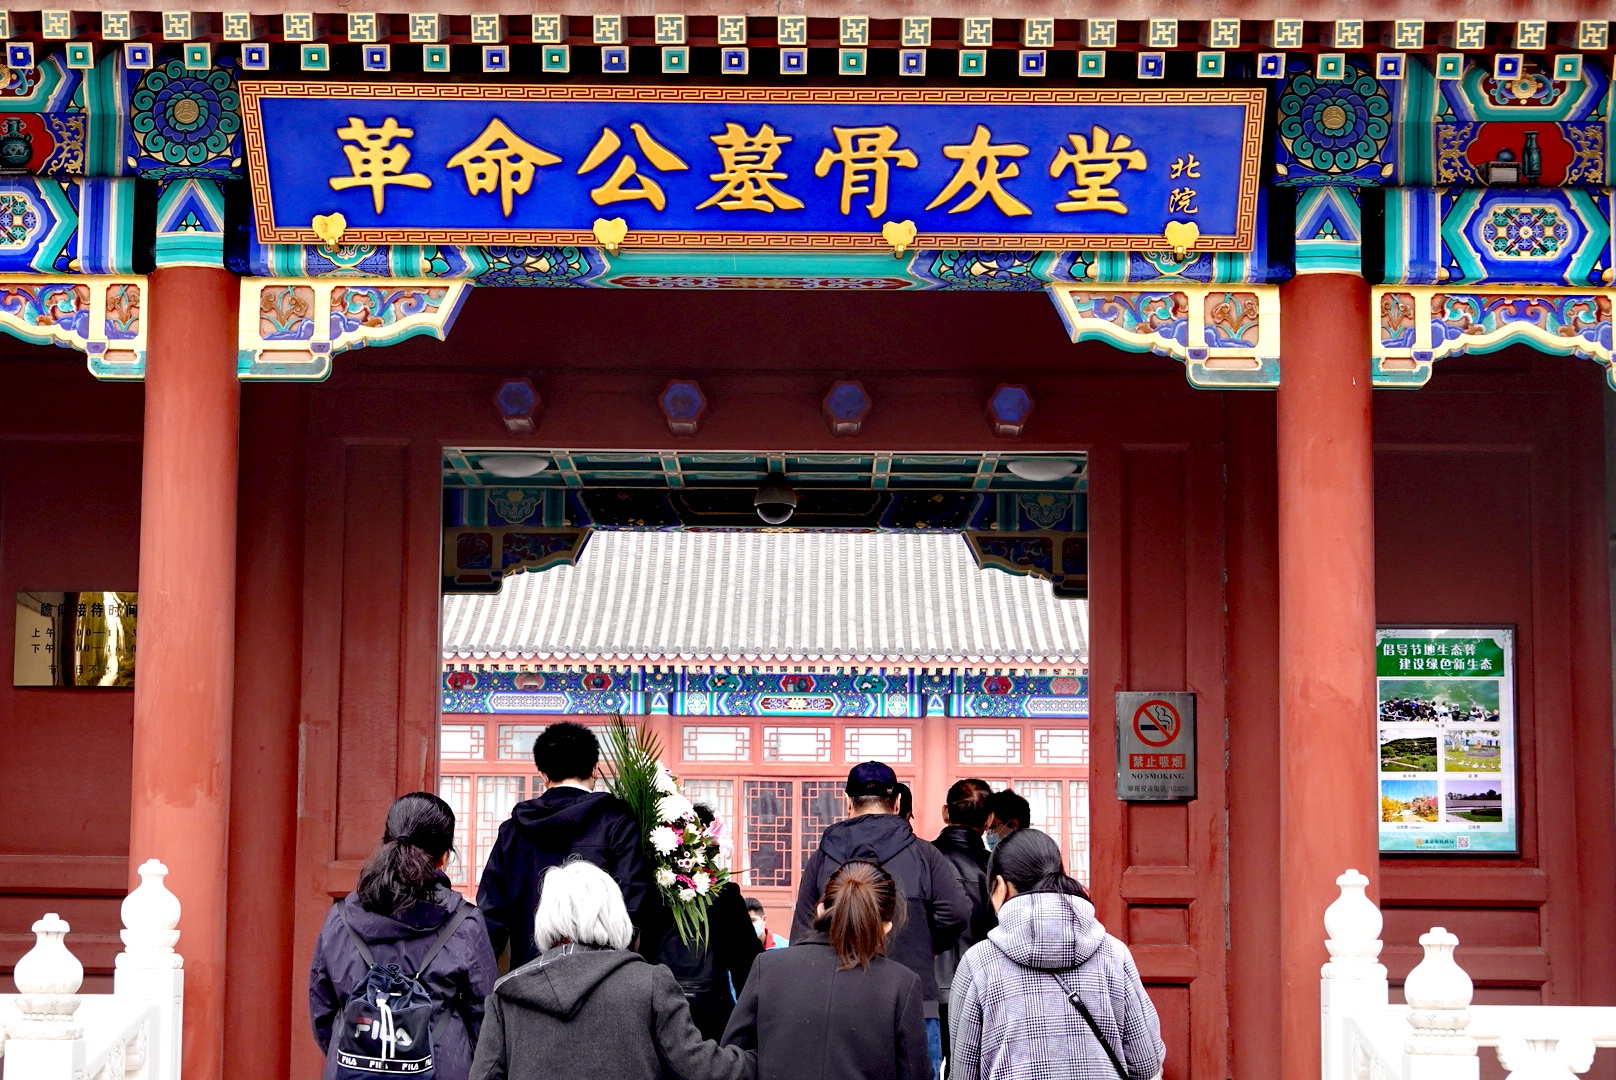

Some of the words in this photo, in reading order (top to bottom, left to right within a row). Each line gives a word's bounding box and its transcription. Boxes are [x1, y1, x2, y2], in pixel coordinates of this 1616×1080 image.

[328, 116, 1148, 219] 革命公墓骨灰堂
[1169, 153, 1201, 213] 北院
[1383, 643, 1477, 656] 倡导节地生态葬
[1399, 658, 1493, 670] 建设绿色新生态
[1132, 755, 1183, 768] 禁止吸烟
[341, 1055, 357, 1066] FILA
[401, 1063, 419, 1071] FILA
